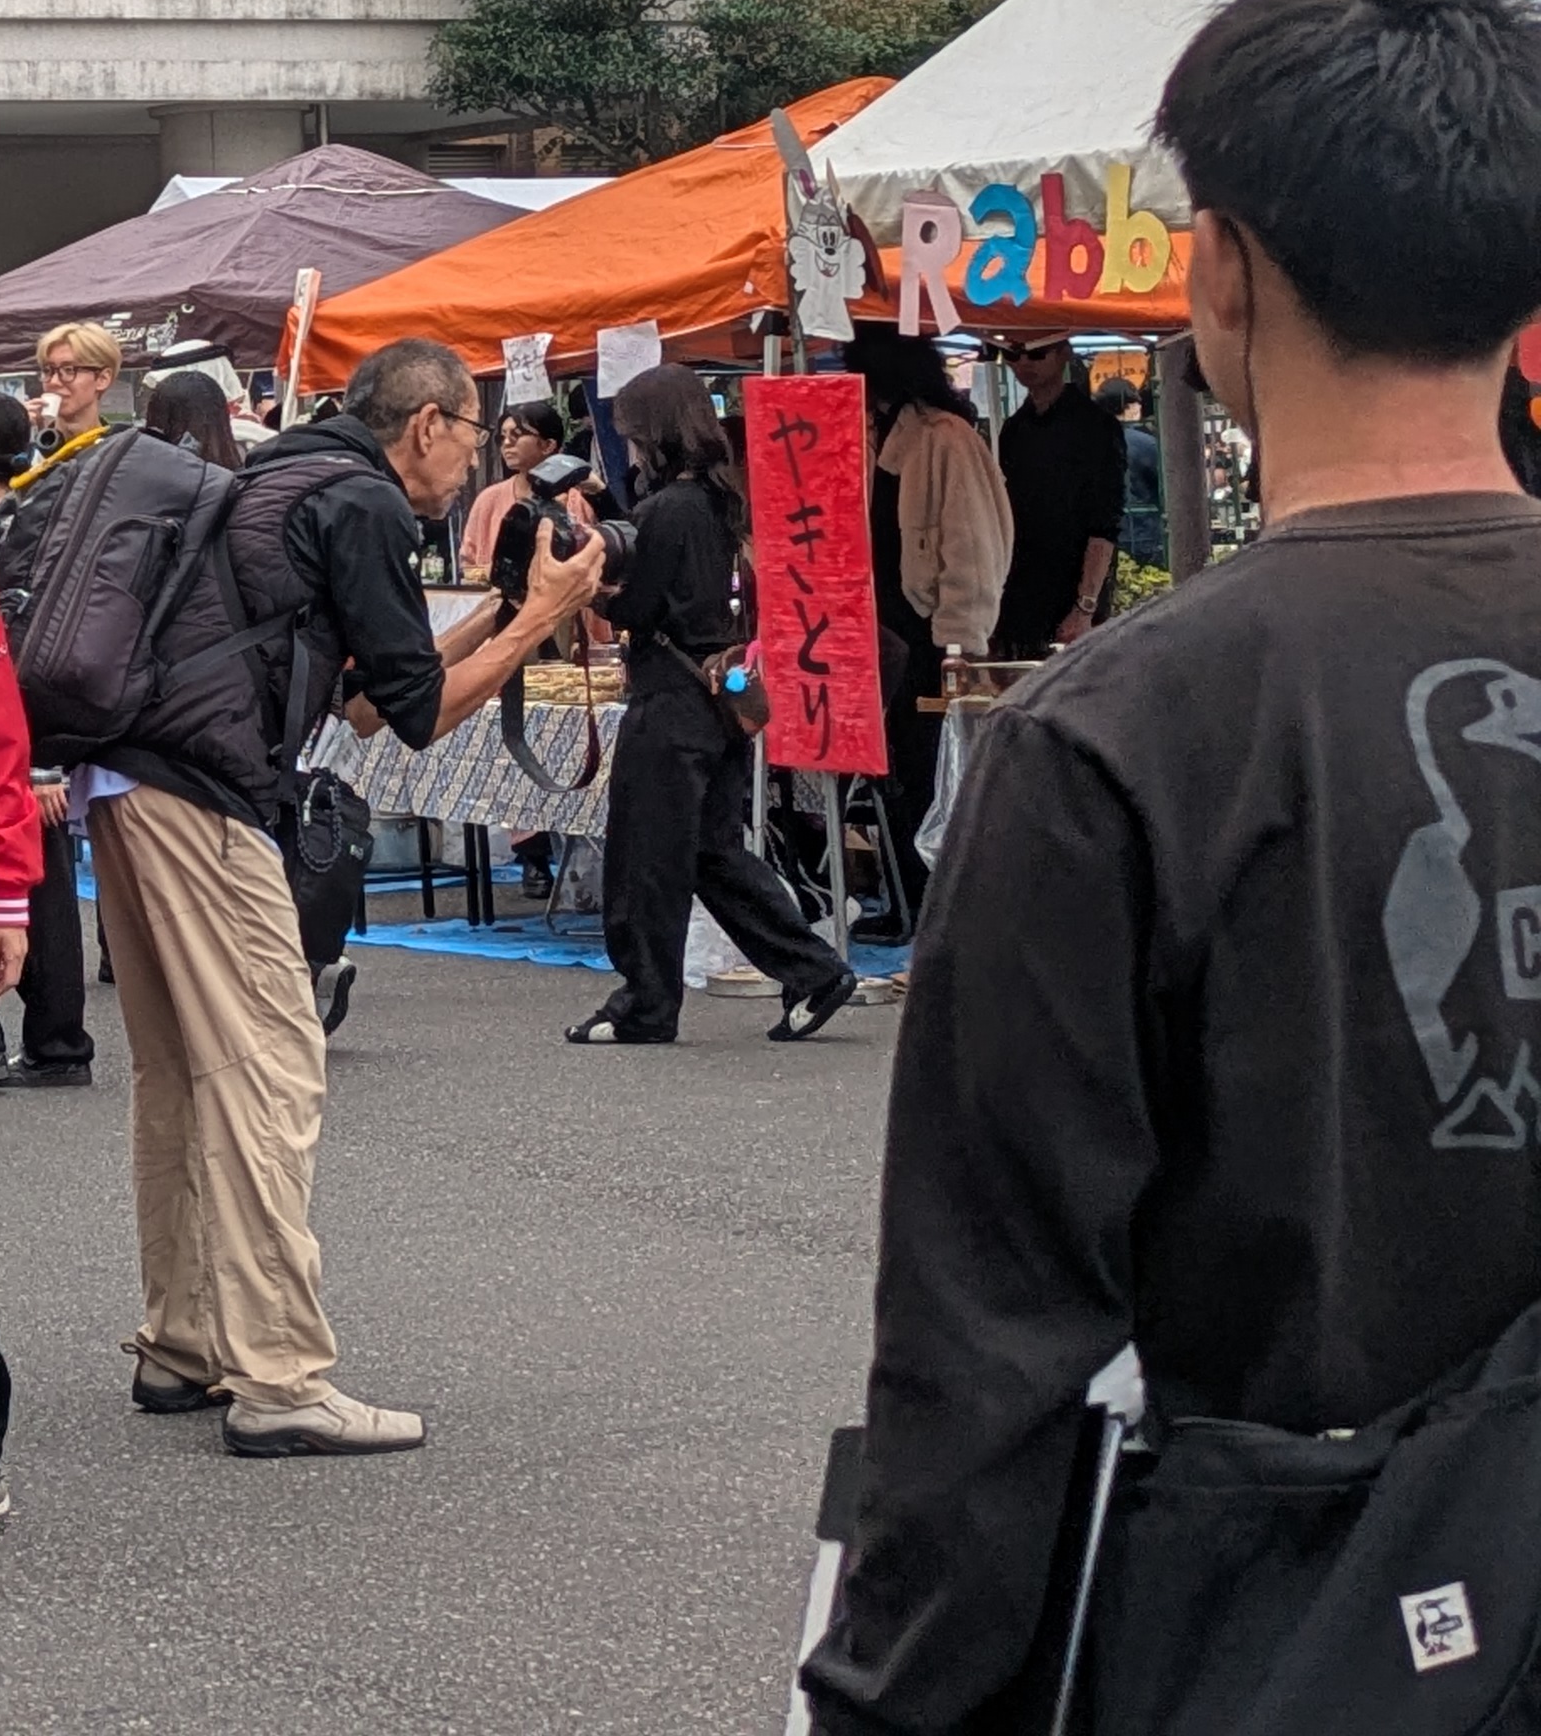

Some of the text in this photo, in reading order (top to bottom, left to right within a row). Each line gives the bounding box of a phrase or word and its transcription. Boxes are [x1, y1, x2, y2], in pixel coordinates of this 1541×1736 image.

[898, 163, 1171, 337] Rabb
[768, 407, 831, 762] やきとり
